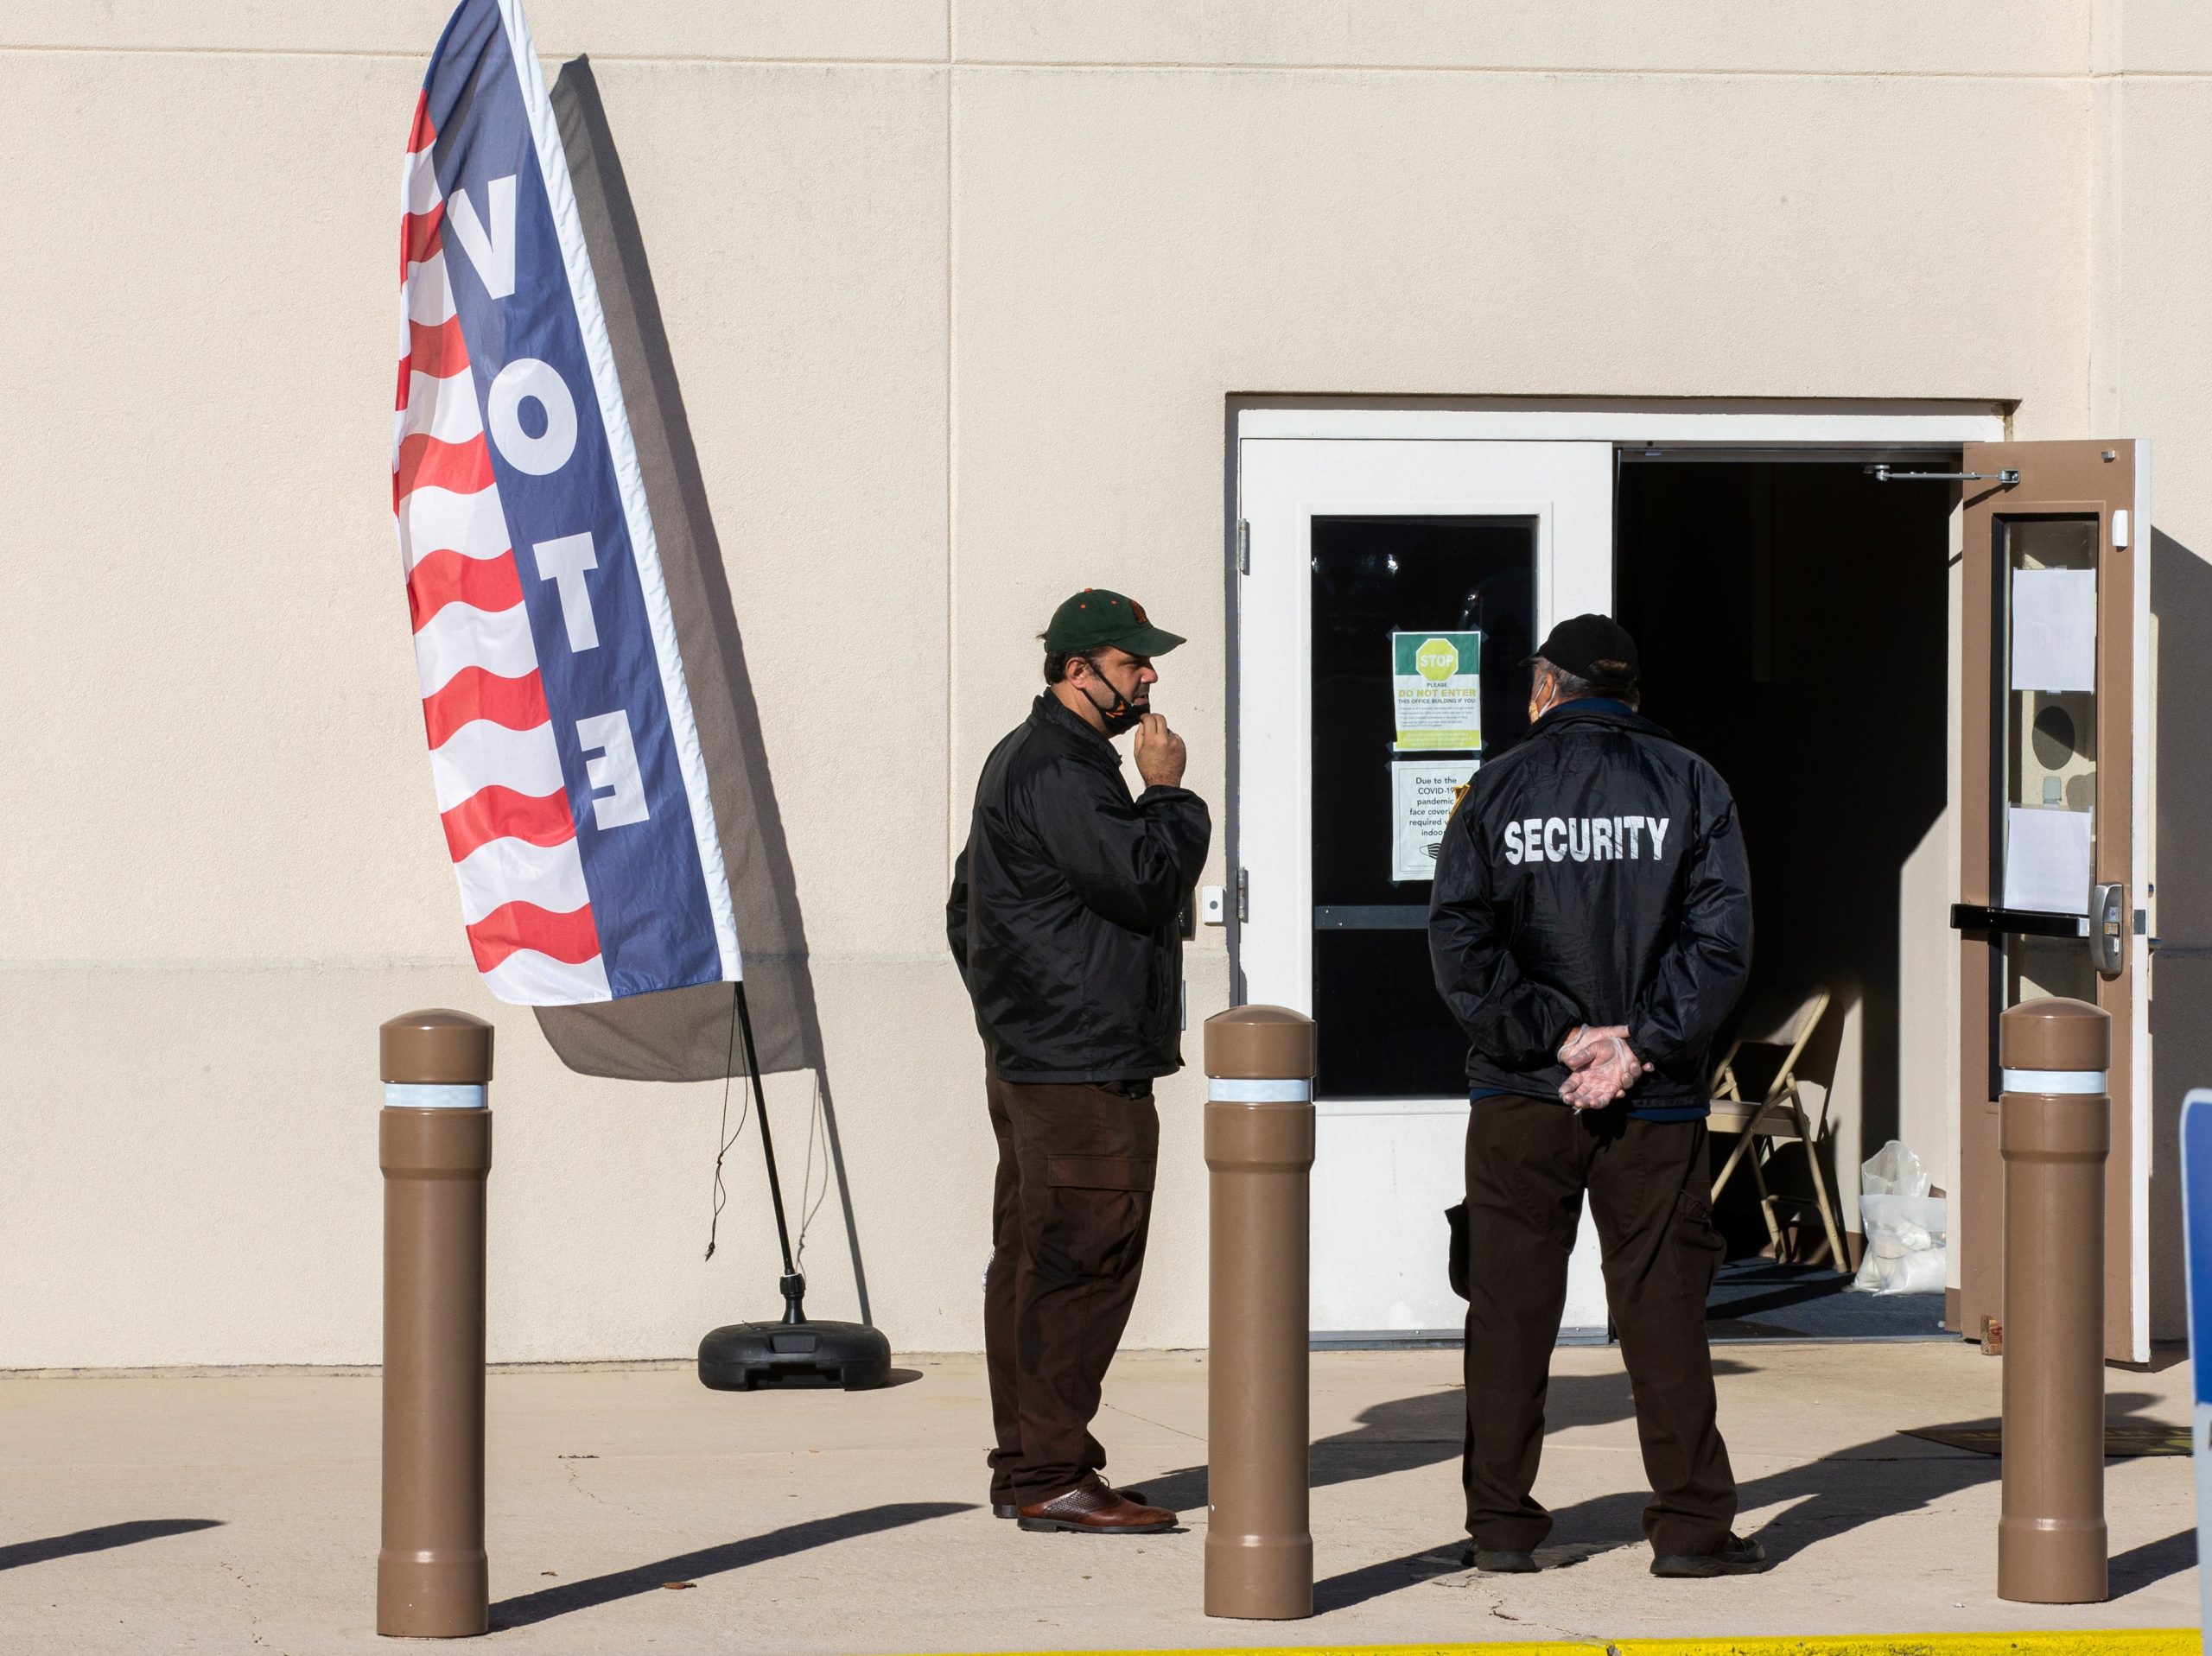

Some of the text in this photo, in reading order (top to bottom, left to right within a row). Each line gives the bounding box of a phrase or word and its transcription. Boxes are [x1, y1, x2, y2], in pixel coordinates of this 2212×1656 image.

[1421, 655, 1454, 668] STOP
[1409, 818, 1442, 827] required
[1503, 815, 1669, 865] SECURITY
